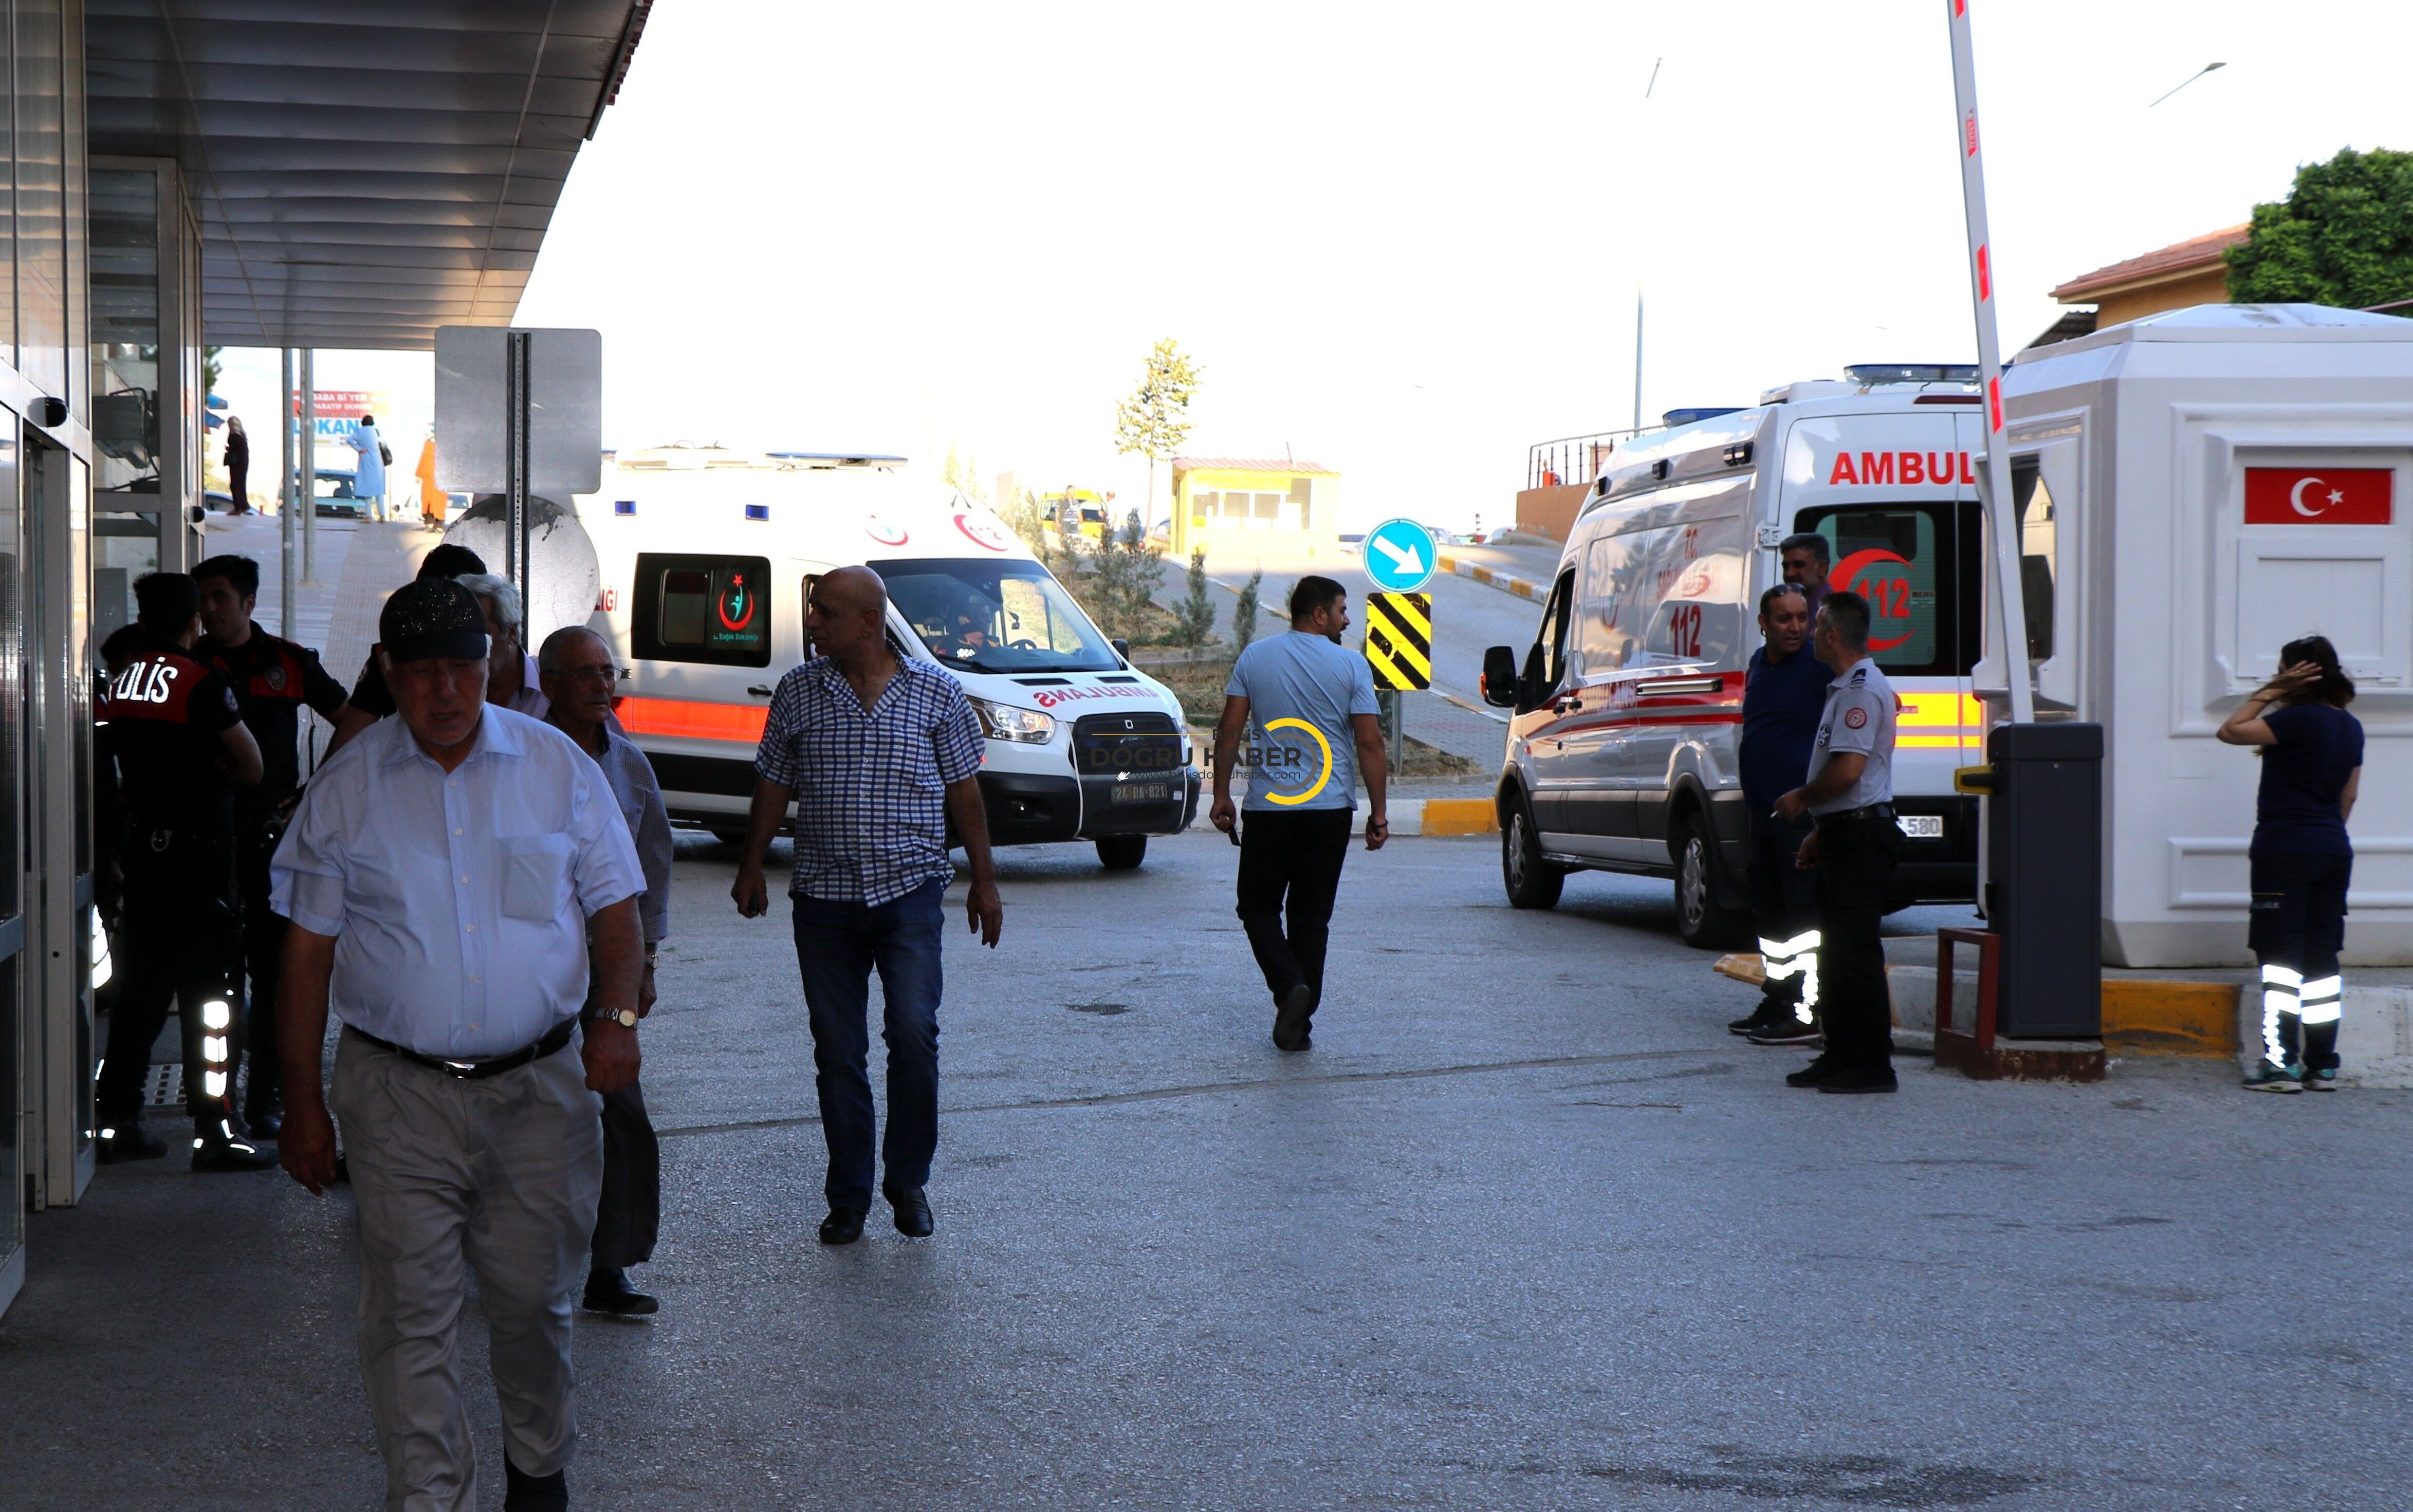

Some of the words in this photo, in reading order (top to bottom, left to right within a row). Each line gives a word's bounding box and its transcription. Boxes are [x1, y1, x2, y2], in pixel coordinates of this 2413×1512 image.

[1671, 604, 1701, 657] 112
[1149, 785, 1164, 798] 821
[1907, 818, 1940, 835] 580
